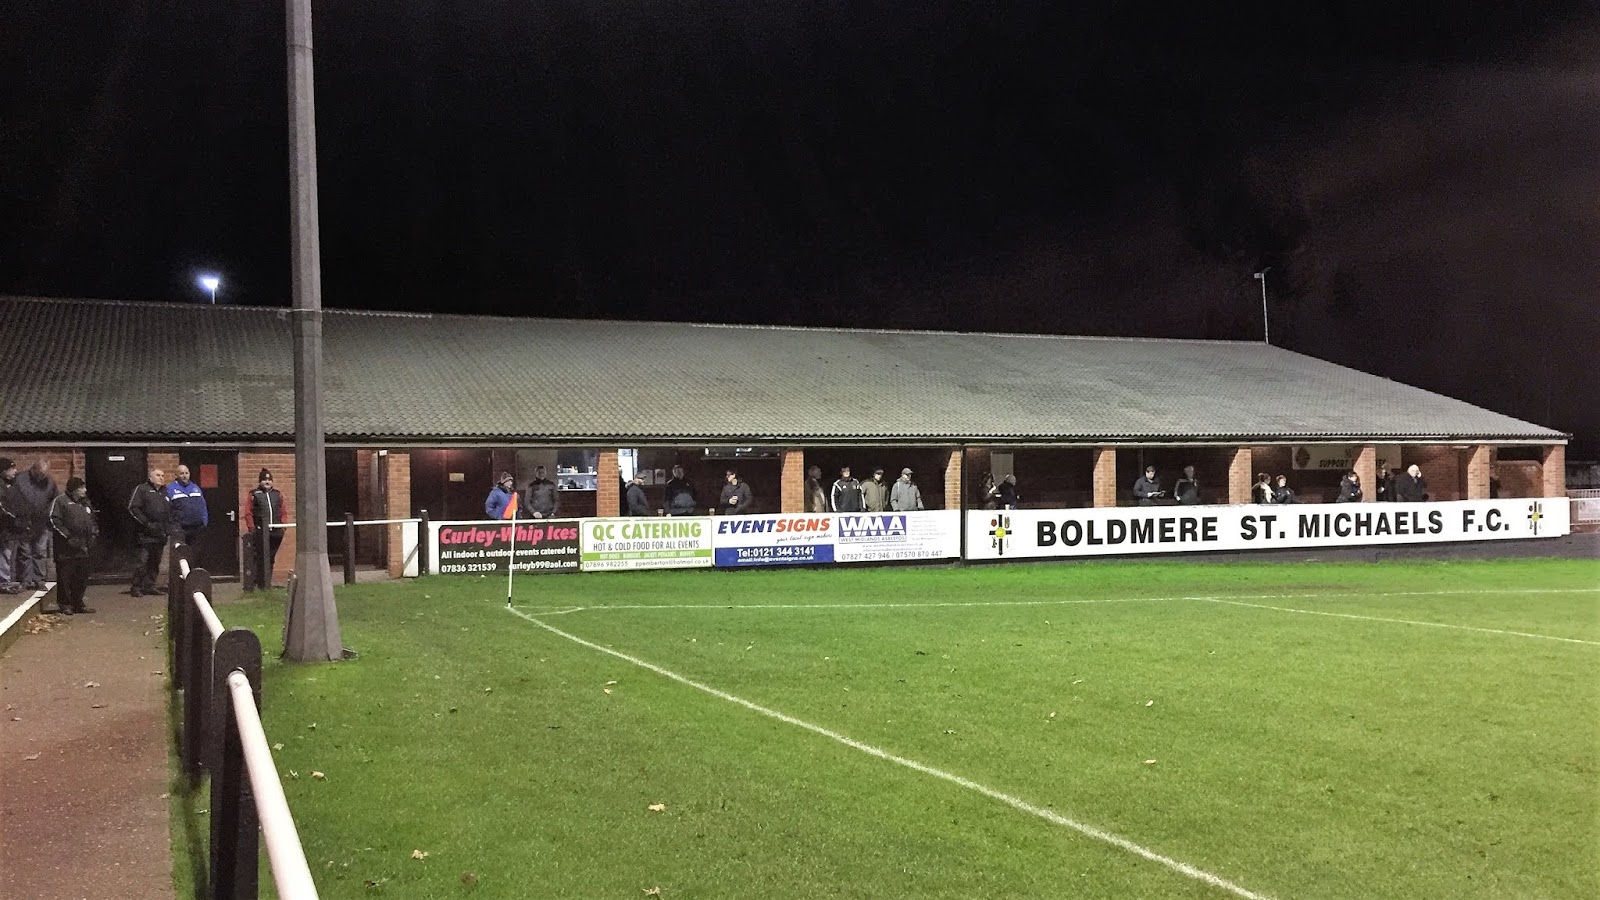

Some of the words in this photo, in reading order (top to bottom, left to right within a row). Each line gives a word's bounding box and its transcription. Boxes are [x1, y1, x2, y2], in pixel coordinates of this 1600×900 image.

[1319, 459, 1348, 468] SUPPORT
[593, 524, 614, 541] QC
[621, 522, 701, 539] CATERING
[718, 518, 830, 534] EVENTSIGNS
[839, 515, 906, 537] WMA
[1037, 516, 1218, 547] BOLDMERE
[1240, 515, 1285, 540] ST.
[1298, 510, 1443, 538] MICHAELS
[1463, 508, 1509, 532] F.C.
[441, 526, 544, 546] Curley-Whip
[547, 526, 577, 540] Ices
[441, 551, 452, 559] All
[453, 550, 477, 558] indoor
[479, 550, 485, 558] &
[515, 548, 539, 556] events
[540, 547, 566, 555] catered
[567, 546, 577, 554] for
[593, 542, 606, 551] HOT
[608, 543, 612, 551] &
[615, 542, 630, 551] COLD
[633, 541, 650, 550] FOOD
[652, 541, 663, 550] FOR
[666, 541, 676, 549] ALL
[678, 540, 700, 549] EVENTS
[737, 548, 774, 557] Tel:0121
[776, 547, 793, 556] 344
[794, 546, 815, 556] 3141
[441, 564, 466, 573] 07836
[468, 563, 496, 572] 321539
